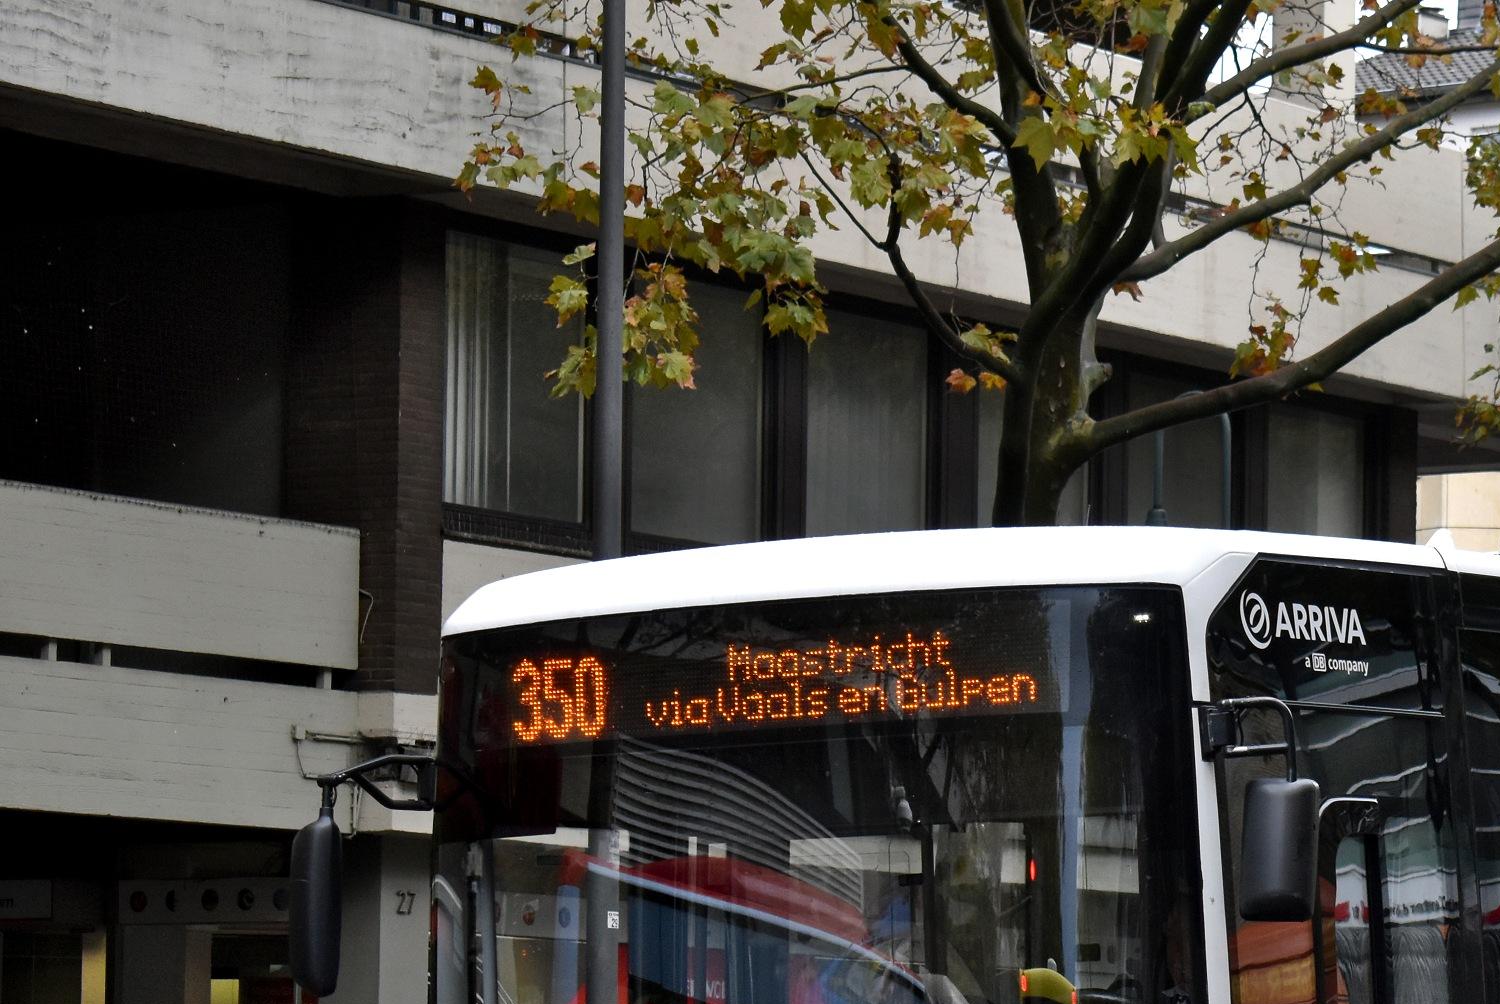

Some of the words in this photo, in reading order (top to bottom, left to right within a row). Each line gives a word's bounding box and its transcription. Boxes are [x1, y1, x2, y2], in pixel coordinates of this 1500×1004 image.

[1275, 601, 1367, 646] ARRIVA
[727, 631, 950, 682] Maastricht
[1305, 658, 1311, 668] a
[1312, 653, 1327, 672] DB
[1328, 658, 1369, 677] company
[512, 657, 606, 741] 350
[645, 688, 710, 727] via
[842, 683, 888, 714] en
[396, 889, 417, 916] 27
